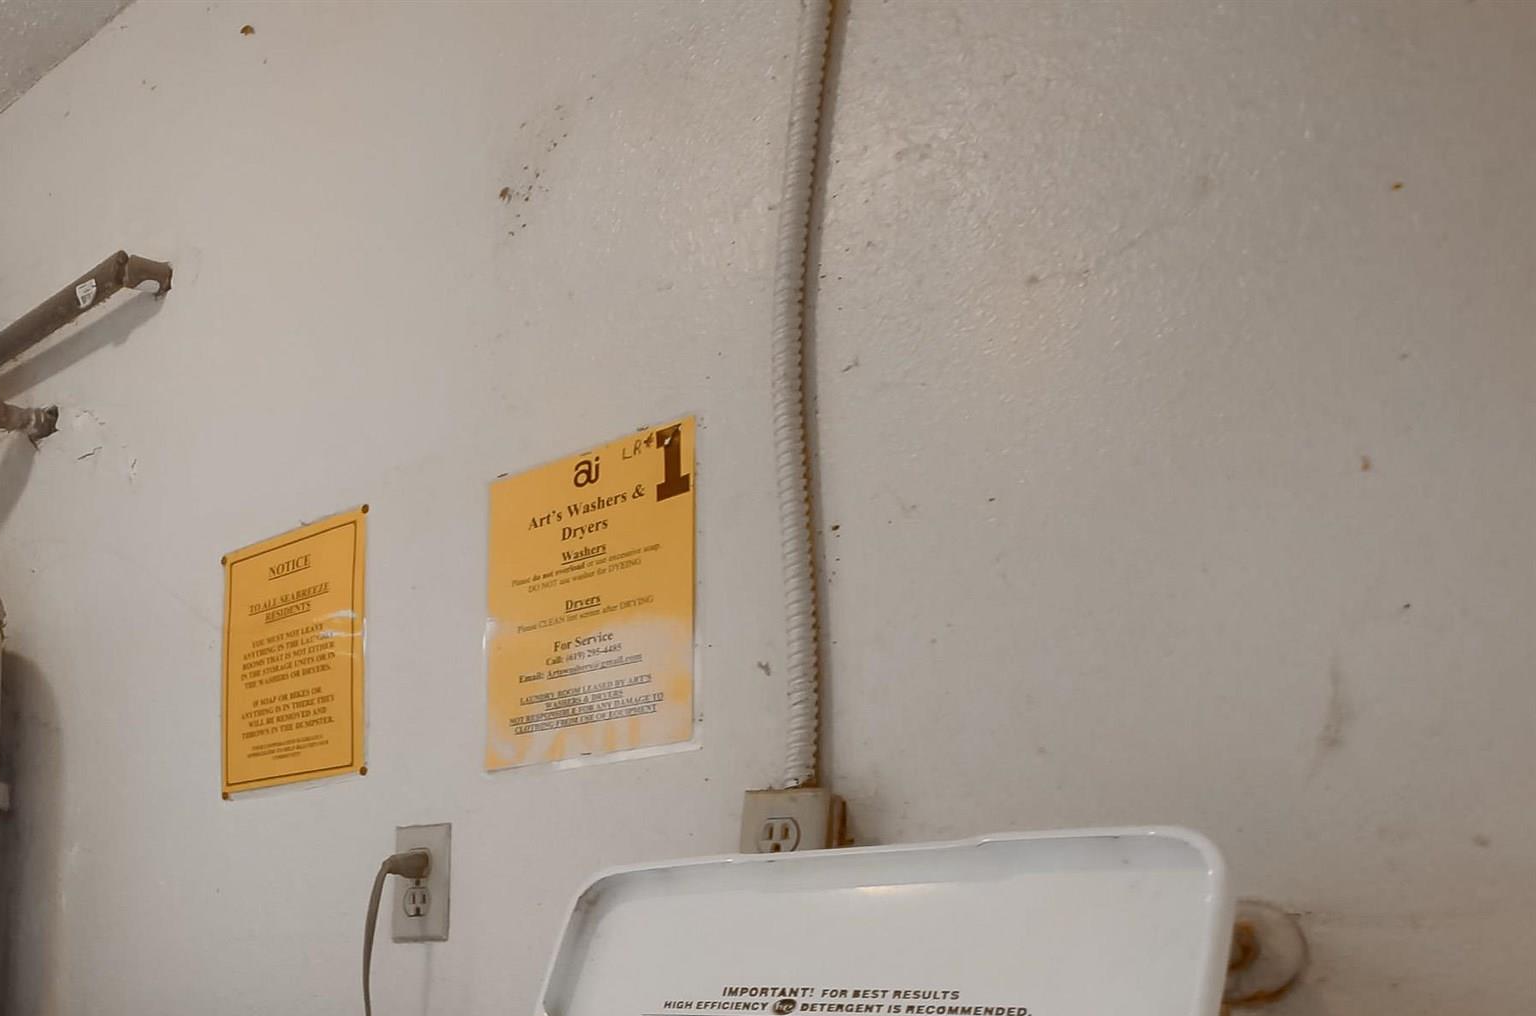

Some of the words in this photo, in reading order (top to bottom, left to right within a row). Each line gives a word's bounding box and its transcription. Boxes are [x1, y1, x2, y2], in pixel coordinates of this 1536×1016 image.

[656, 423, 690, 502] 1
[528, 510, 563, 530] Art's
[567, 492, 627, 518] Washers
[631, 484, 646, 500] &
[561, 519, 608, 541] Dryers
[562, 544, 606, 562] Washers
[268, 554, 311, 577] NOTICE
[565, 595, 601, 611] Dryers
[553, 640, 572, 652] For
[574, 632, 614, 648] Service
[722, 986, 814, 999] IMPORTANT!
[820, 989, 848, 999] FOR
[852, 989, 889, 999] BEST
[892, 990, 961, 1001] RESULTS
[663, 1001, 694, 1010] HIGH
[696, 1001, 769, 1012] EFFICIENCY
[800, 1003, 885, 1014] DETERGENT
[887, 1005, 902, 1014] IS
[905, 1005, 1033, 1016] RECOMMENDED.
